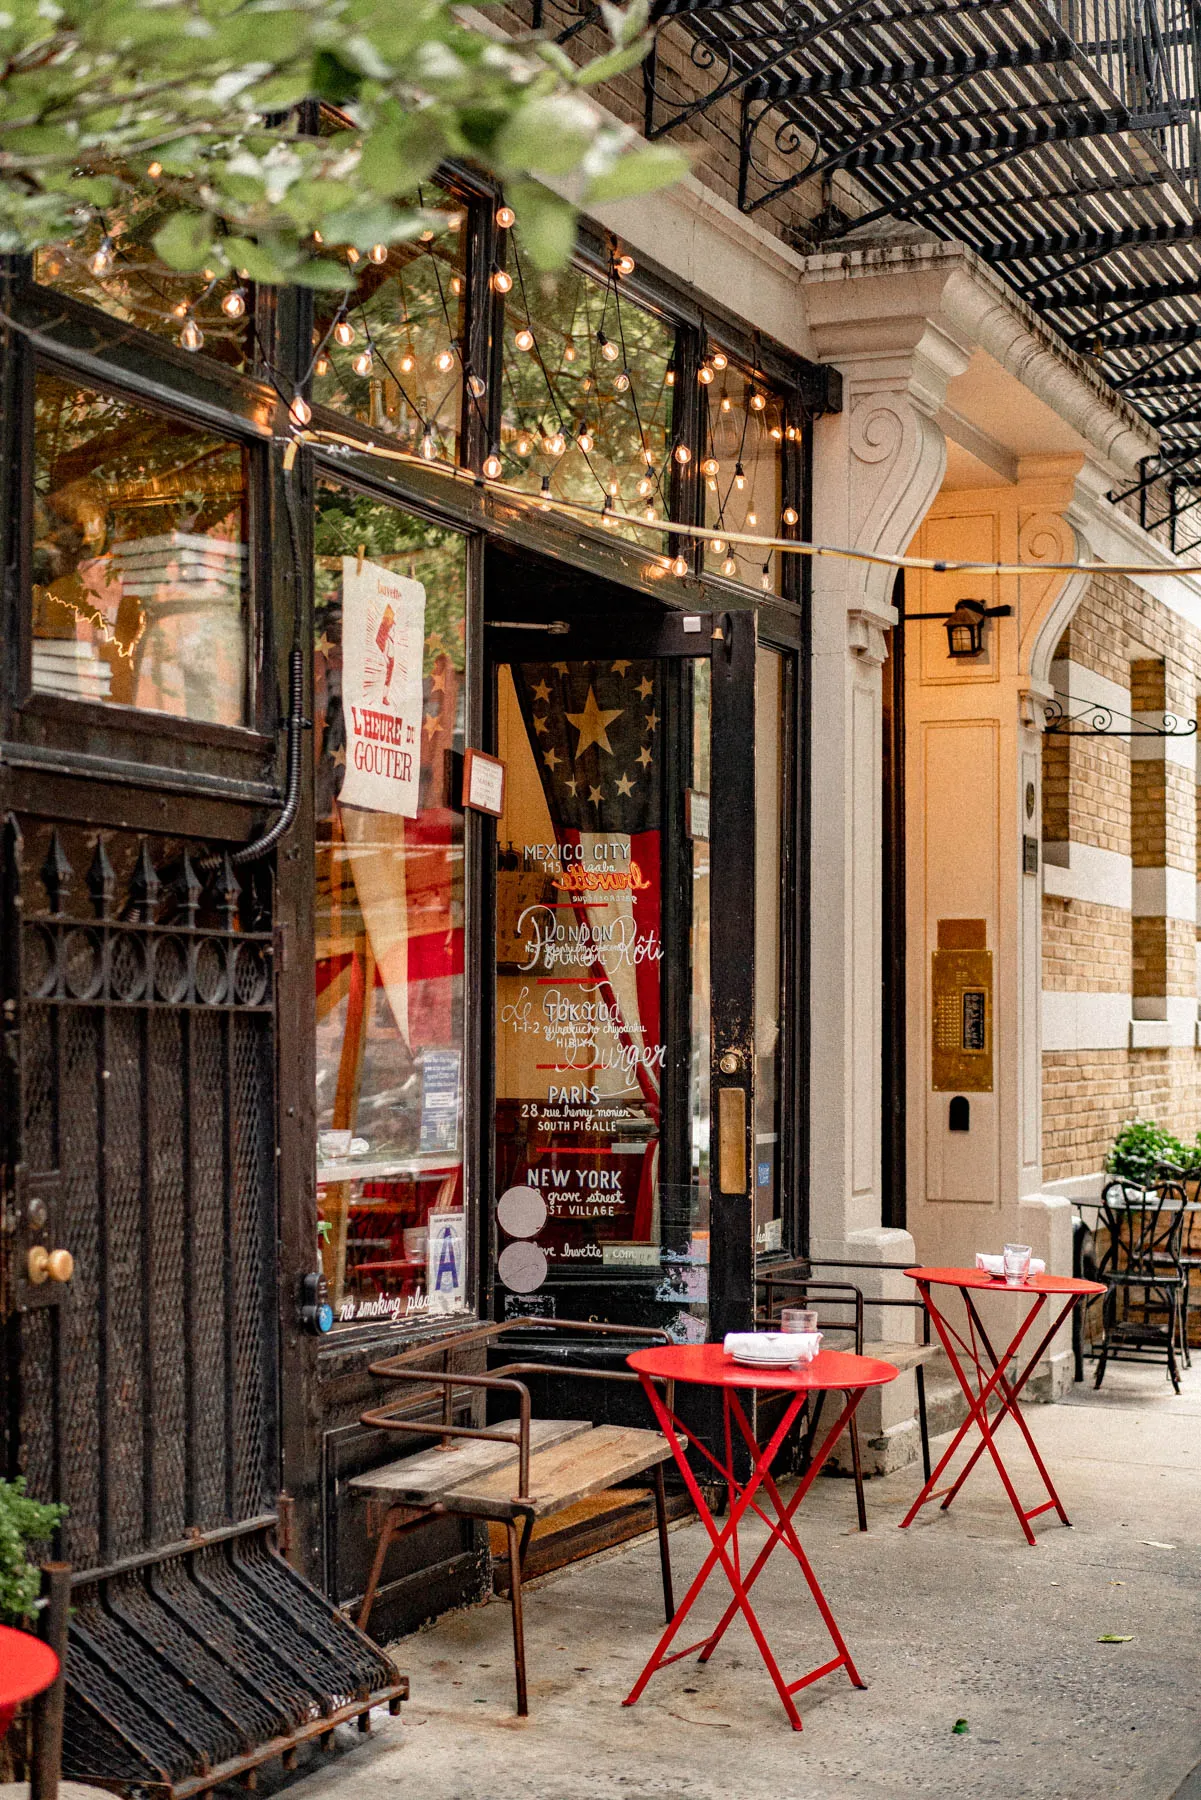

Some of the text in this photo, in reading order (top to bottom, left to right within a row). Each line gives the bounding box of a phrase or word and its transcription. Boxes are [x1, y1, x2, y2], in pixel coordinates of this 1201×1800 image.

[351, 706, 403, 746] L'HEURE
[354, 741, 412, 782] GOUTER
[524, 843, 631, 861] MEXICO CITY
[542, 862, 561, 873] 145
[545, 924, 613, 943] LONDON
[608, 915, 665, 974] Rôti
[501, 986, 532, 1023] Le
[547, 1003, 609, 1022] TOKYO
[513, 1022, 540, 1034] 1-1-2
[548, 1085, 600, 1105] PARIS
[521, 1103, 631, 1121] 28 rue henry monier
[537, 1120, 617, 1132] SOUTH PIGALLE
[527, 1168, 622, 1190] NEW YORK
[547, 1191, 583, 1205] grove
[585, 1189, 626, 1205] street
[546, 1205, 615, 1217] ST VILLAGE
[435, 1227, 459, 1291] A
[340, 1303, 356, 1321] no
[356, 1292, 401, 1320] smoking
[405, 1286, 434, 1316] plea
